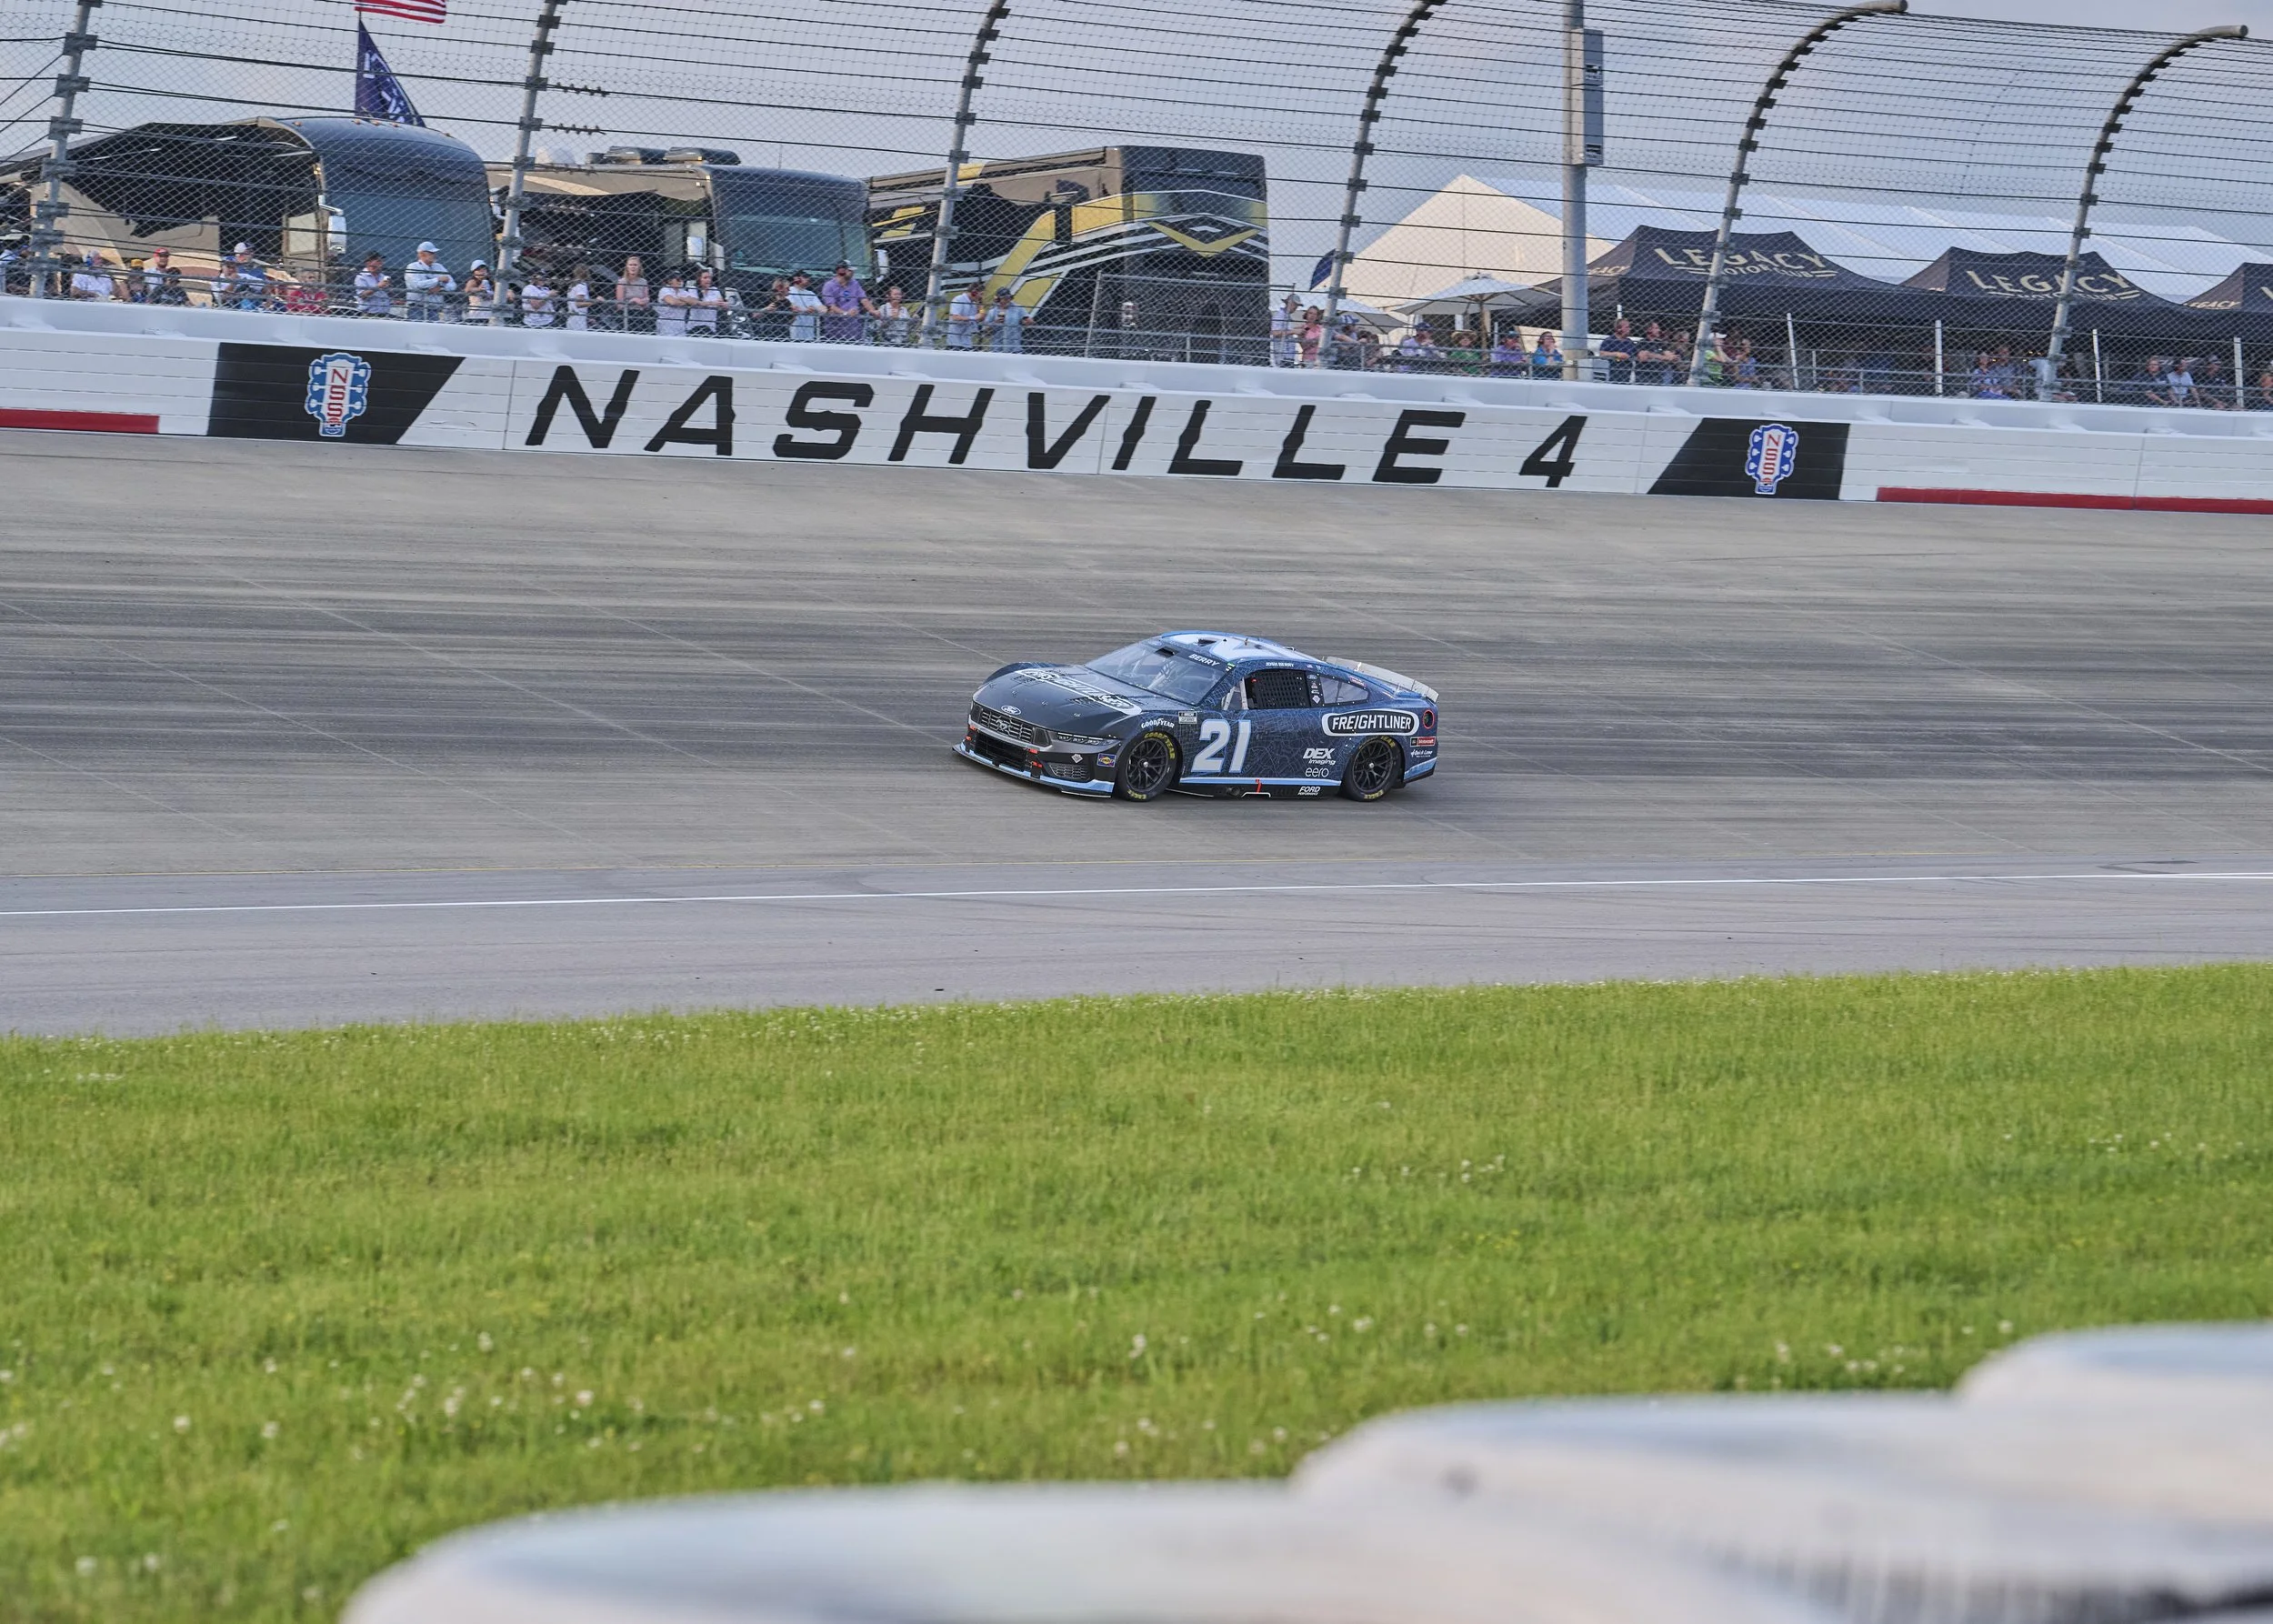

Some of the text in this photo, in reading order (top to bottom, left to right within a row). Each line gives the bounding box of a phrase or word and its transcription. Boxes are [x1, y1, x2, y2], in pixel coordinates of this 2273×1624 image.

[526, 366, 1587, 487] NASHVILLE 4
[1188, 653, 1220, 667] BERRY
[1141, 717, 1176, 729] GOODYEAR
[1332, 714, 1412, 730] FREIGHTLINER
[1191, 718, 1251, 773] 21
[1303, 747, 1336, 759] DEX
[1305, 767, 1329, 777] eero
